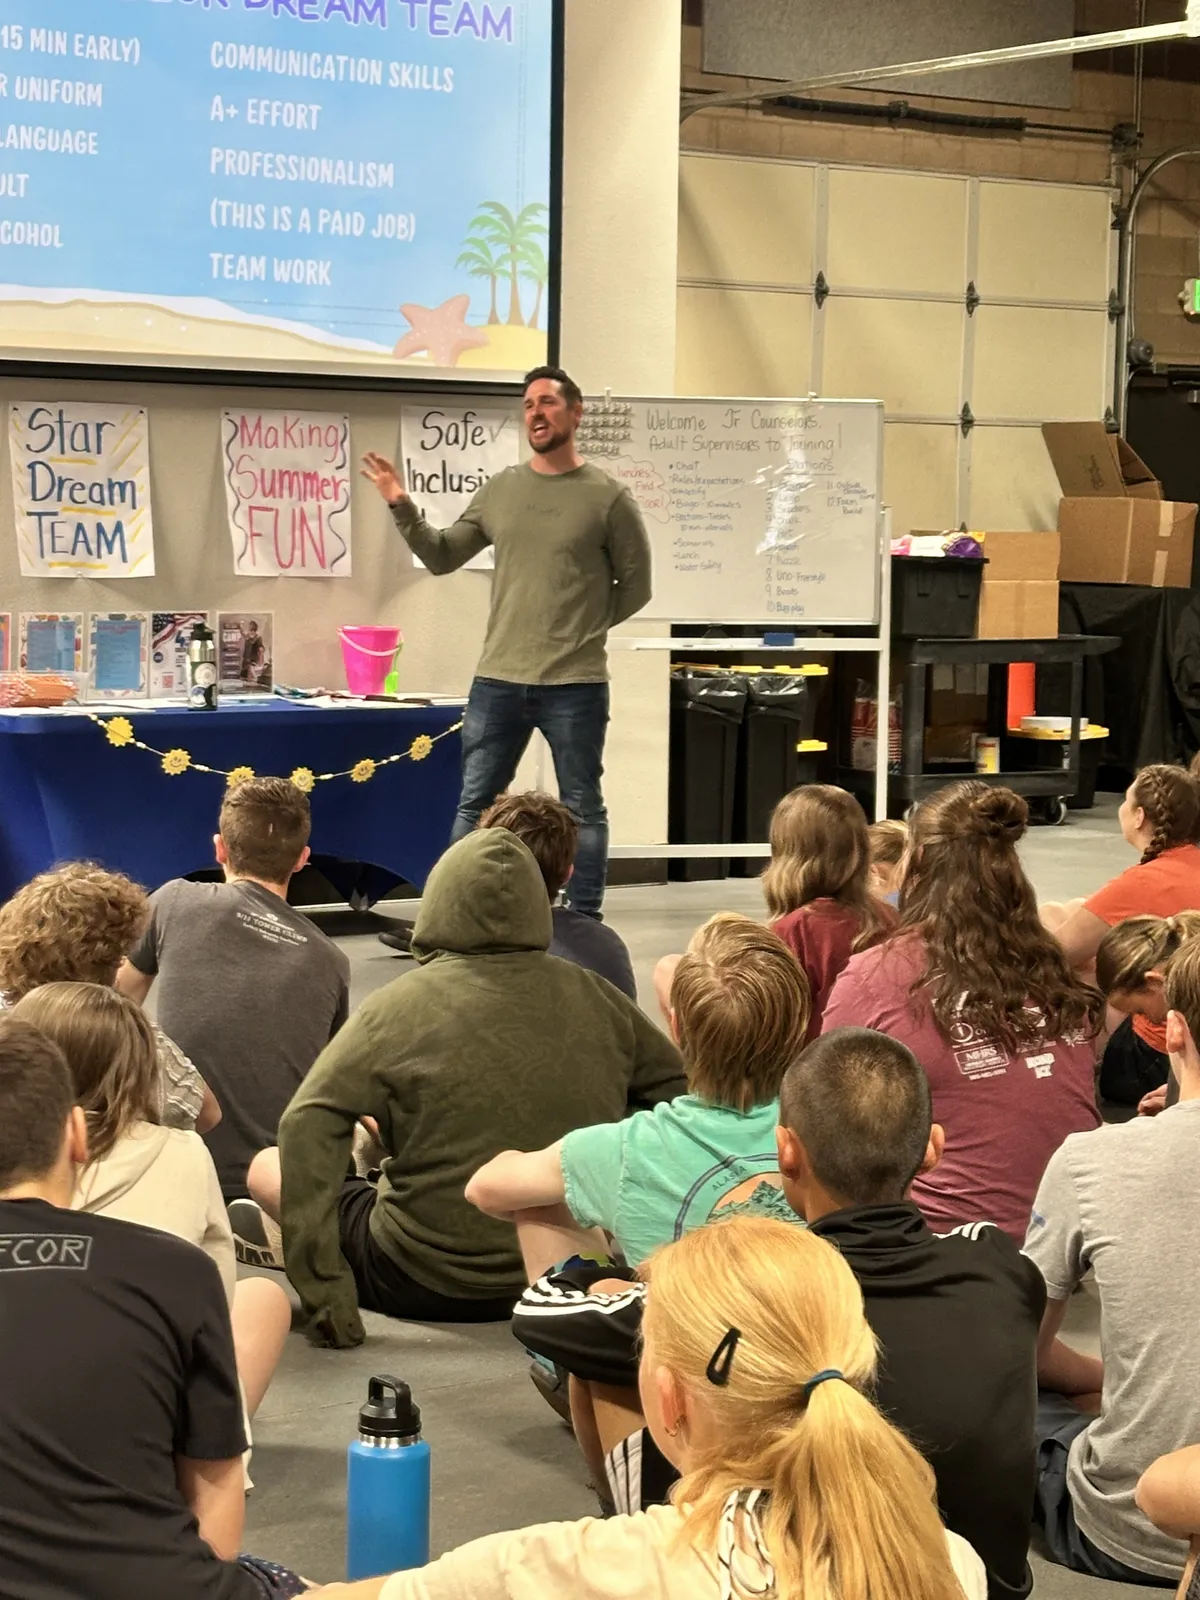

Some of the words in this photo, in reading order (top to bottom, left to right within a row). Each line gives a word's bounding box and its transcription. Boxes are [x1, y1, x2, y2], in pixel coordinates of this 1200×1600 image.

[246, 0, 387, 28] EAM
[399, 0, 512, 42] TEAM
[30, 27, 67, 56] MIN
[73, 33, 141, 65] EARLY)
[210, 41, 383, 86] COMMUNICATION
[388, 61, 454, 93] SKILLS
[15, 75, 102, 108] UNIFORM
[210, 94, 239, 122] A+
[247, 98, 322, 130] EFFORT
[210, 147, 394, 188] PROFESSIONALISM
[0, 219, 64, 248] COHOL
[210, 198, 266, 231] (THIS
[273, 205, 292, 233] IS
[298, 208, 311, 235] A
[318, 208, 365, 239] PAID
[371, 212, 416, 243] JOB)
[209, 252, 266, 282] TEAM
[273, 257, 332, 286] WORK
[26, 408, 116, 454] Star
[420, 411, 487, 451] Safe
[646, 409, 707, 431] Welcome
[649, 435, 688, 452] Adult
[27, 460, 137, 510] Dream
[235, 454, 349, 502] Summer
[406, 457, 490, 494] Inclusi
[26, 511, 128, 563] TEAM
[248, 504, 327, 570] FUN
